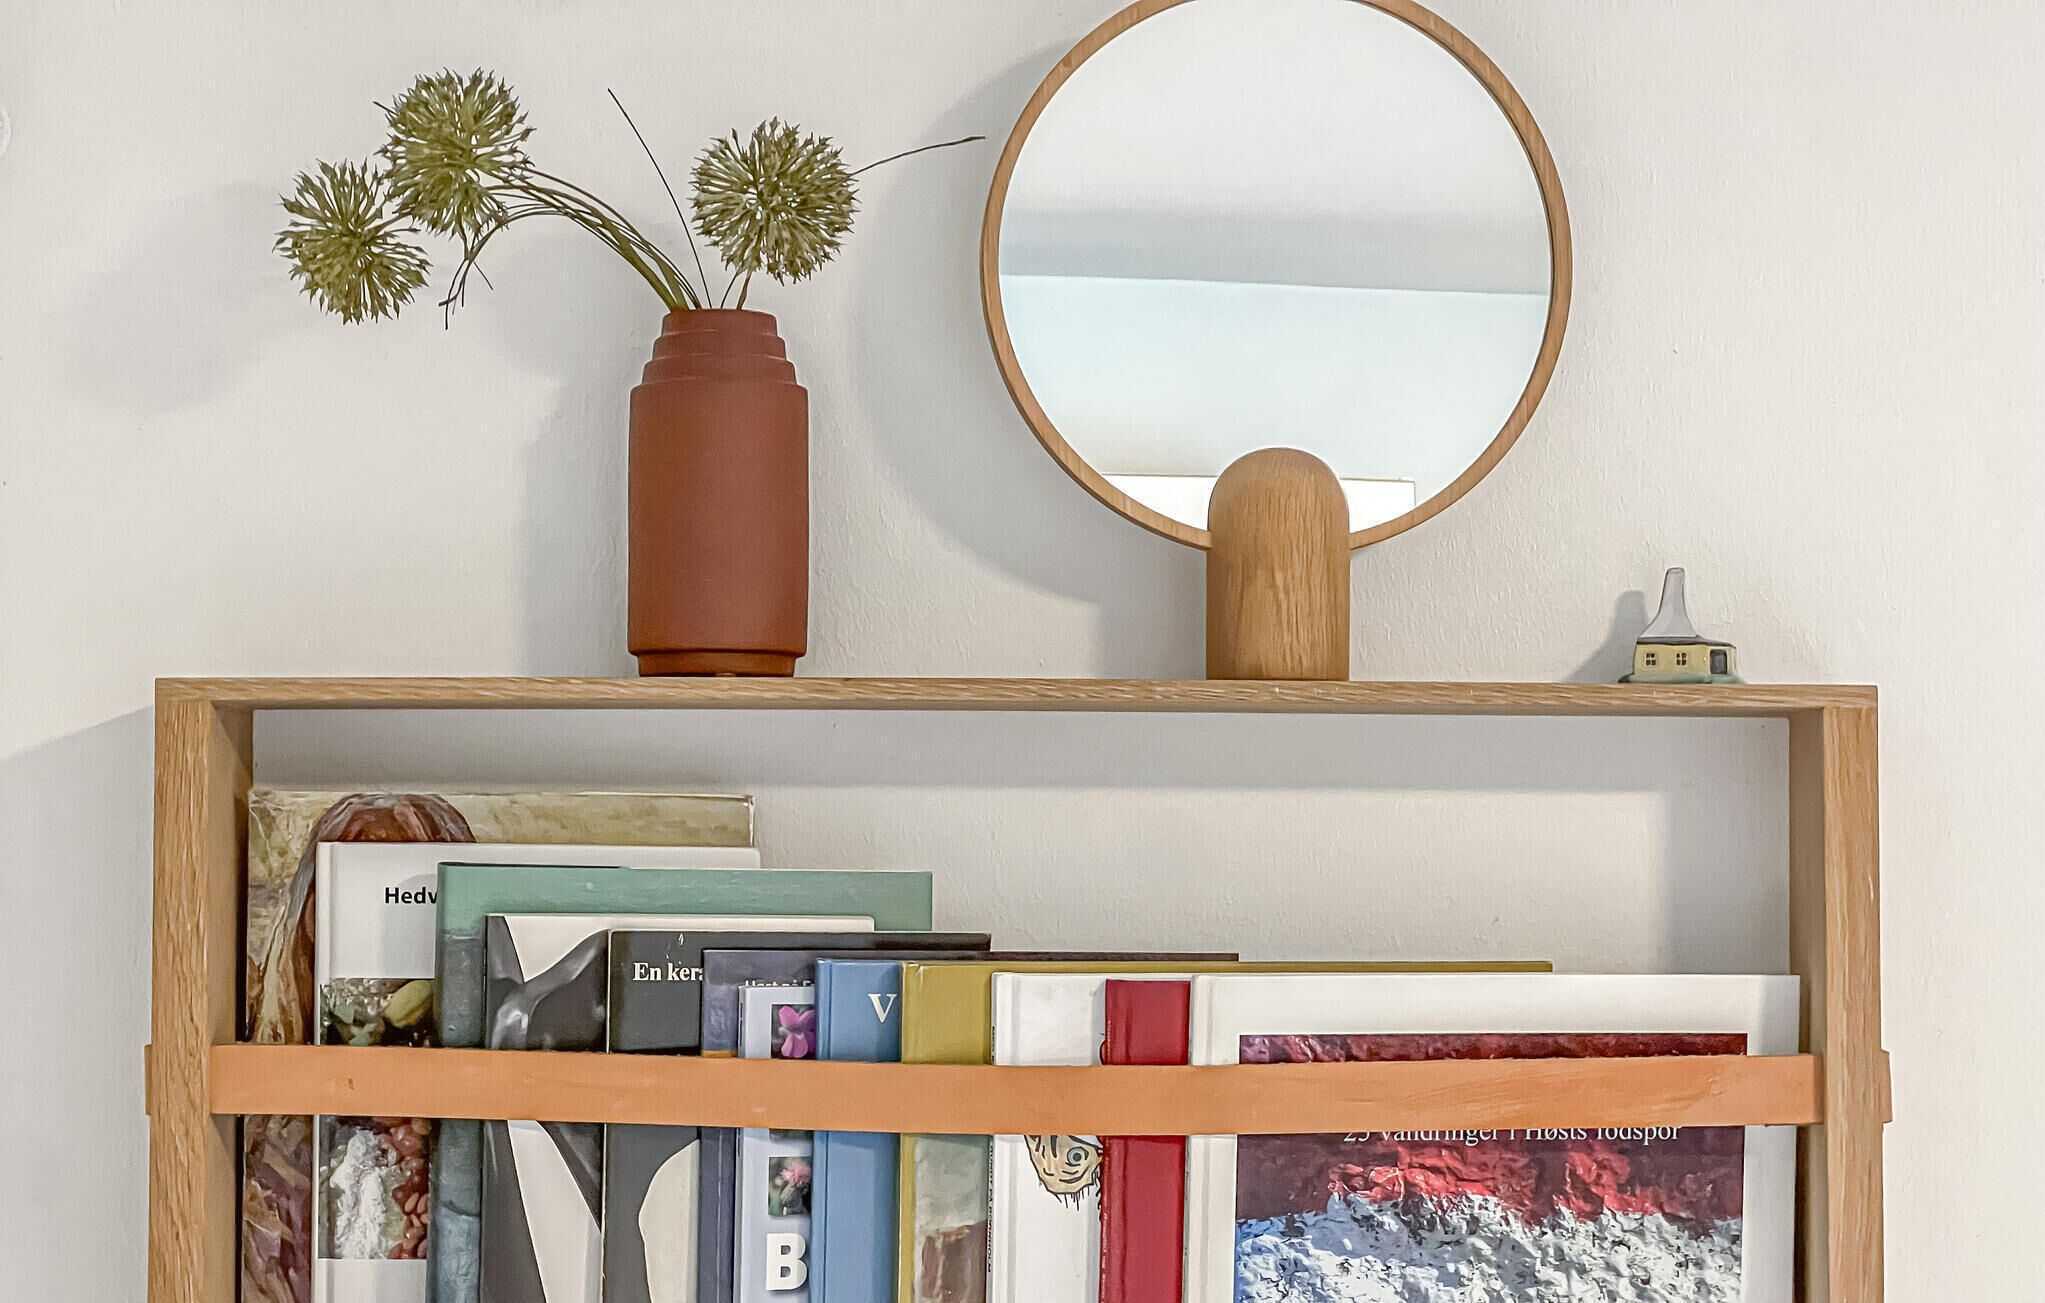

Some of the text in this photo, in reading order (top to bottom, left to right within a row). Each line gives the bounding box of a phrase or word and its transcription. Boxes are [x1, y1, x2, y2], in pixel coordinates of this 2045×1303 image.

[385, 886, 438, 904] Hedv
[633, 962, 662, 981] En
[868, 993, 898, 1023] V
[766, 1233, 808, 1291] B
